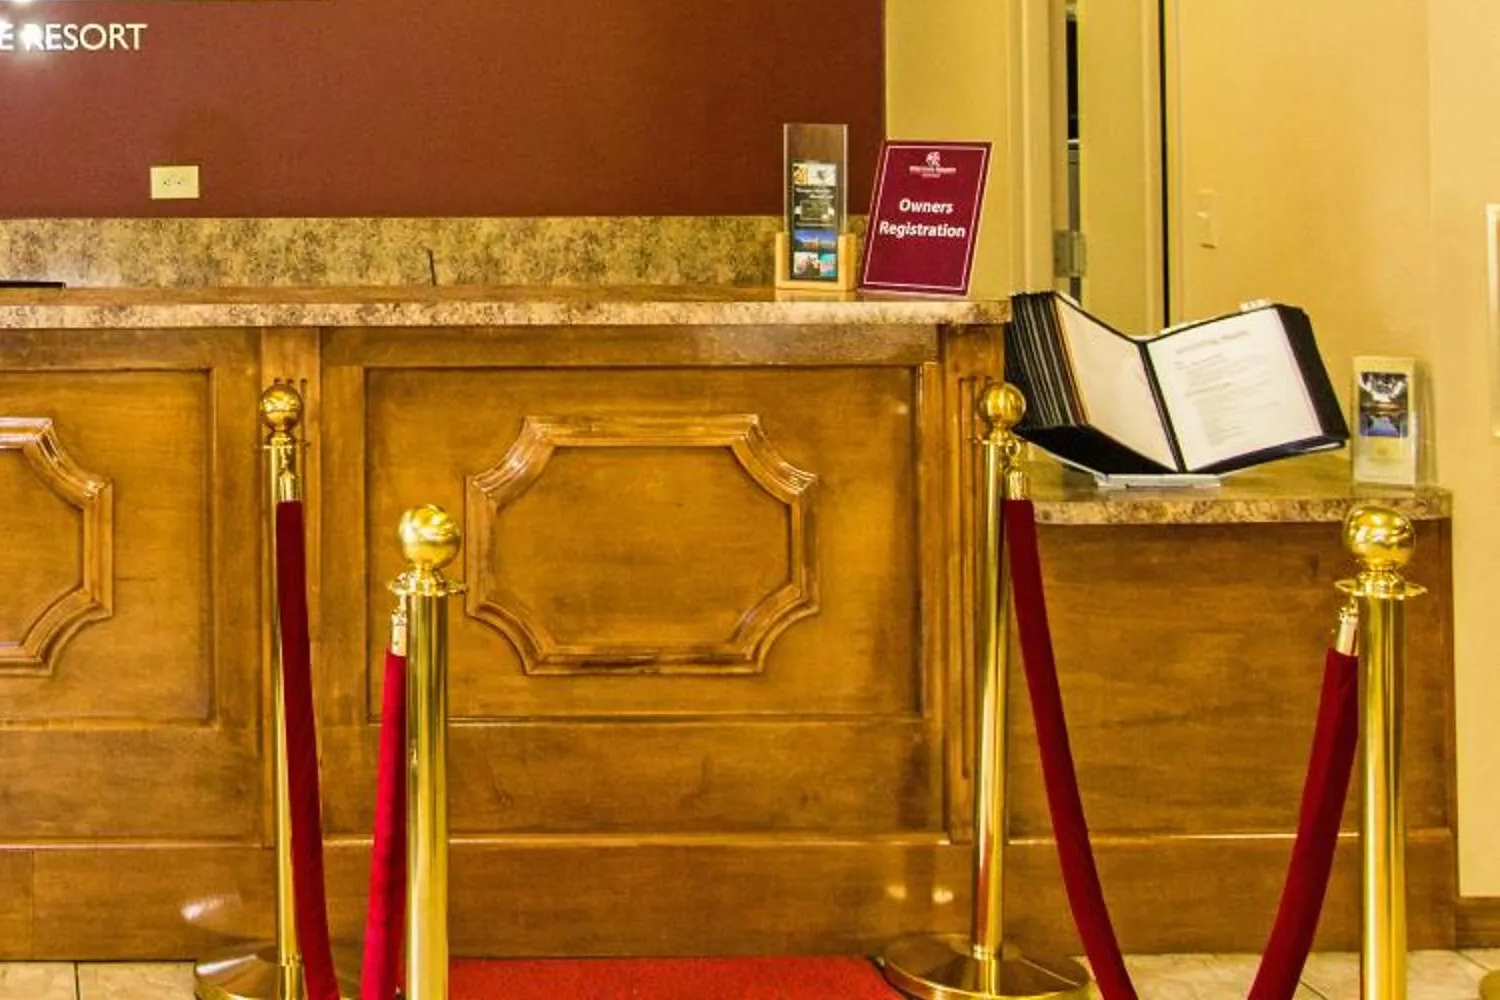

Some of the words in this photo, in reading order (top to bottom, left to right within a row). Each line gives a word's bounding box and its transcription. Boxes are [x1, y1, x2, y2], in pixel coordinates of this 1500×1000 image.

[22, 23, 148, 51] RESORT
[899, 197, 954, 214] Owners
[879, 221, 966, 239] Registration
